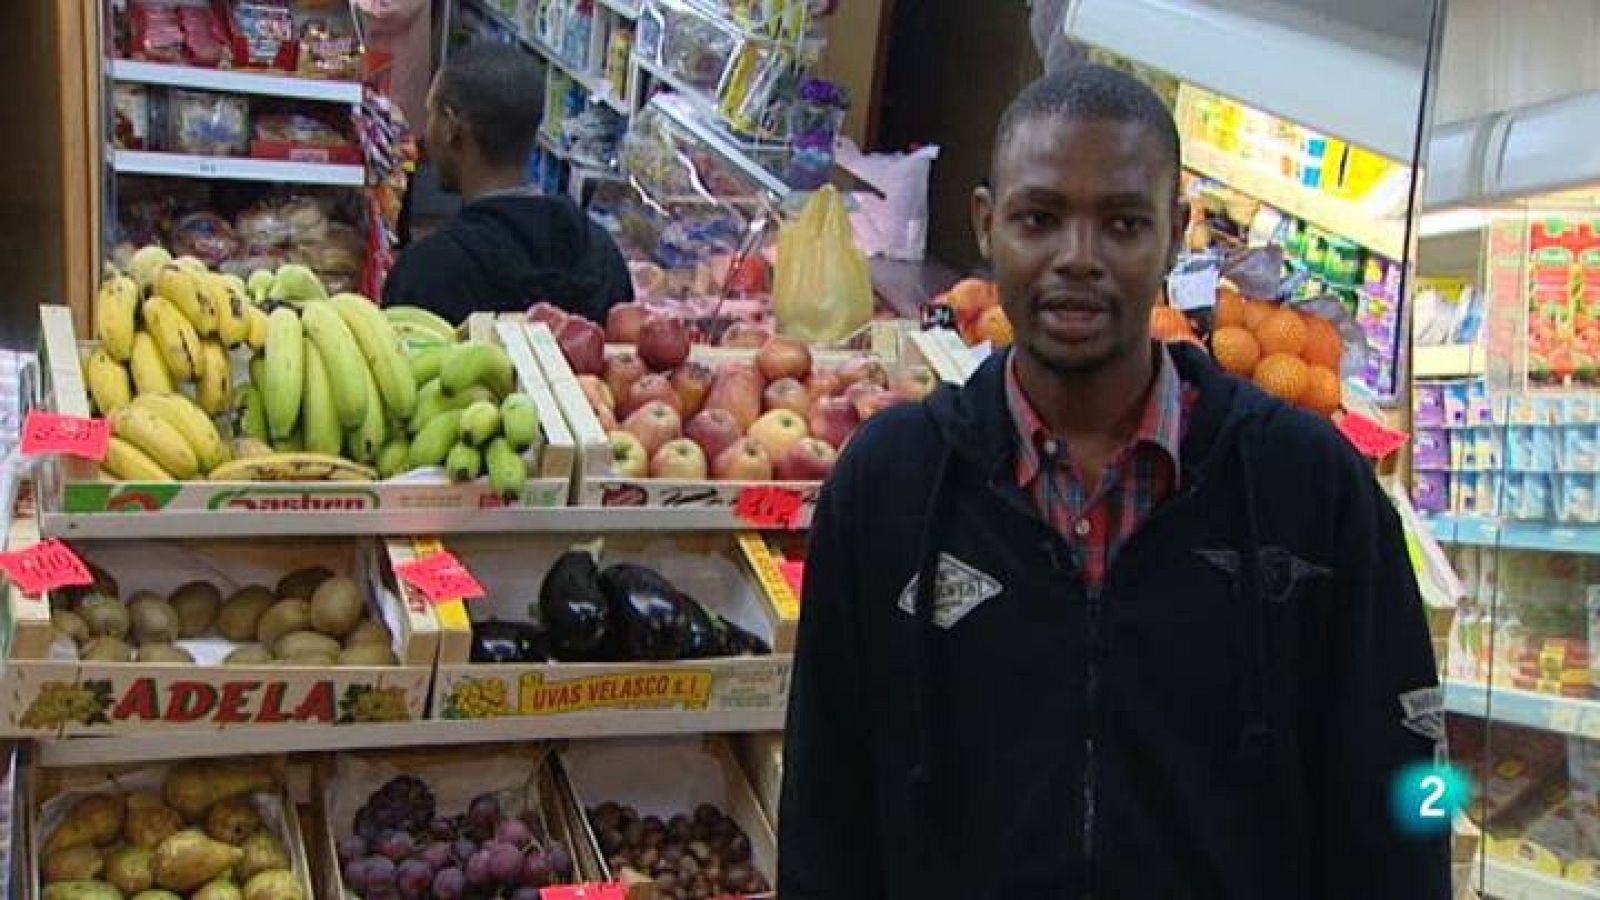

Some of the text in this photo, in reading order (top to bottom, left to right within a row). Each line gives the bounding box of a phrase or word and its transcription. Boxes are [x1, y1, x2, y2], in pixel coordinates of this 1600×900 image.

[112, 677, 337, 724] ADELA
[532, 683, 583, 711] UVAS
[588, 674, 671, 701] VELASCO
